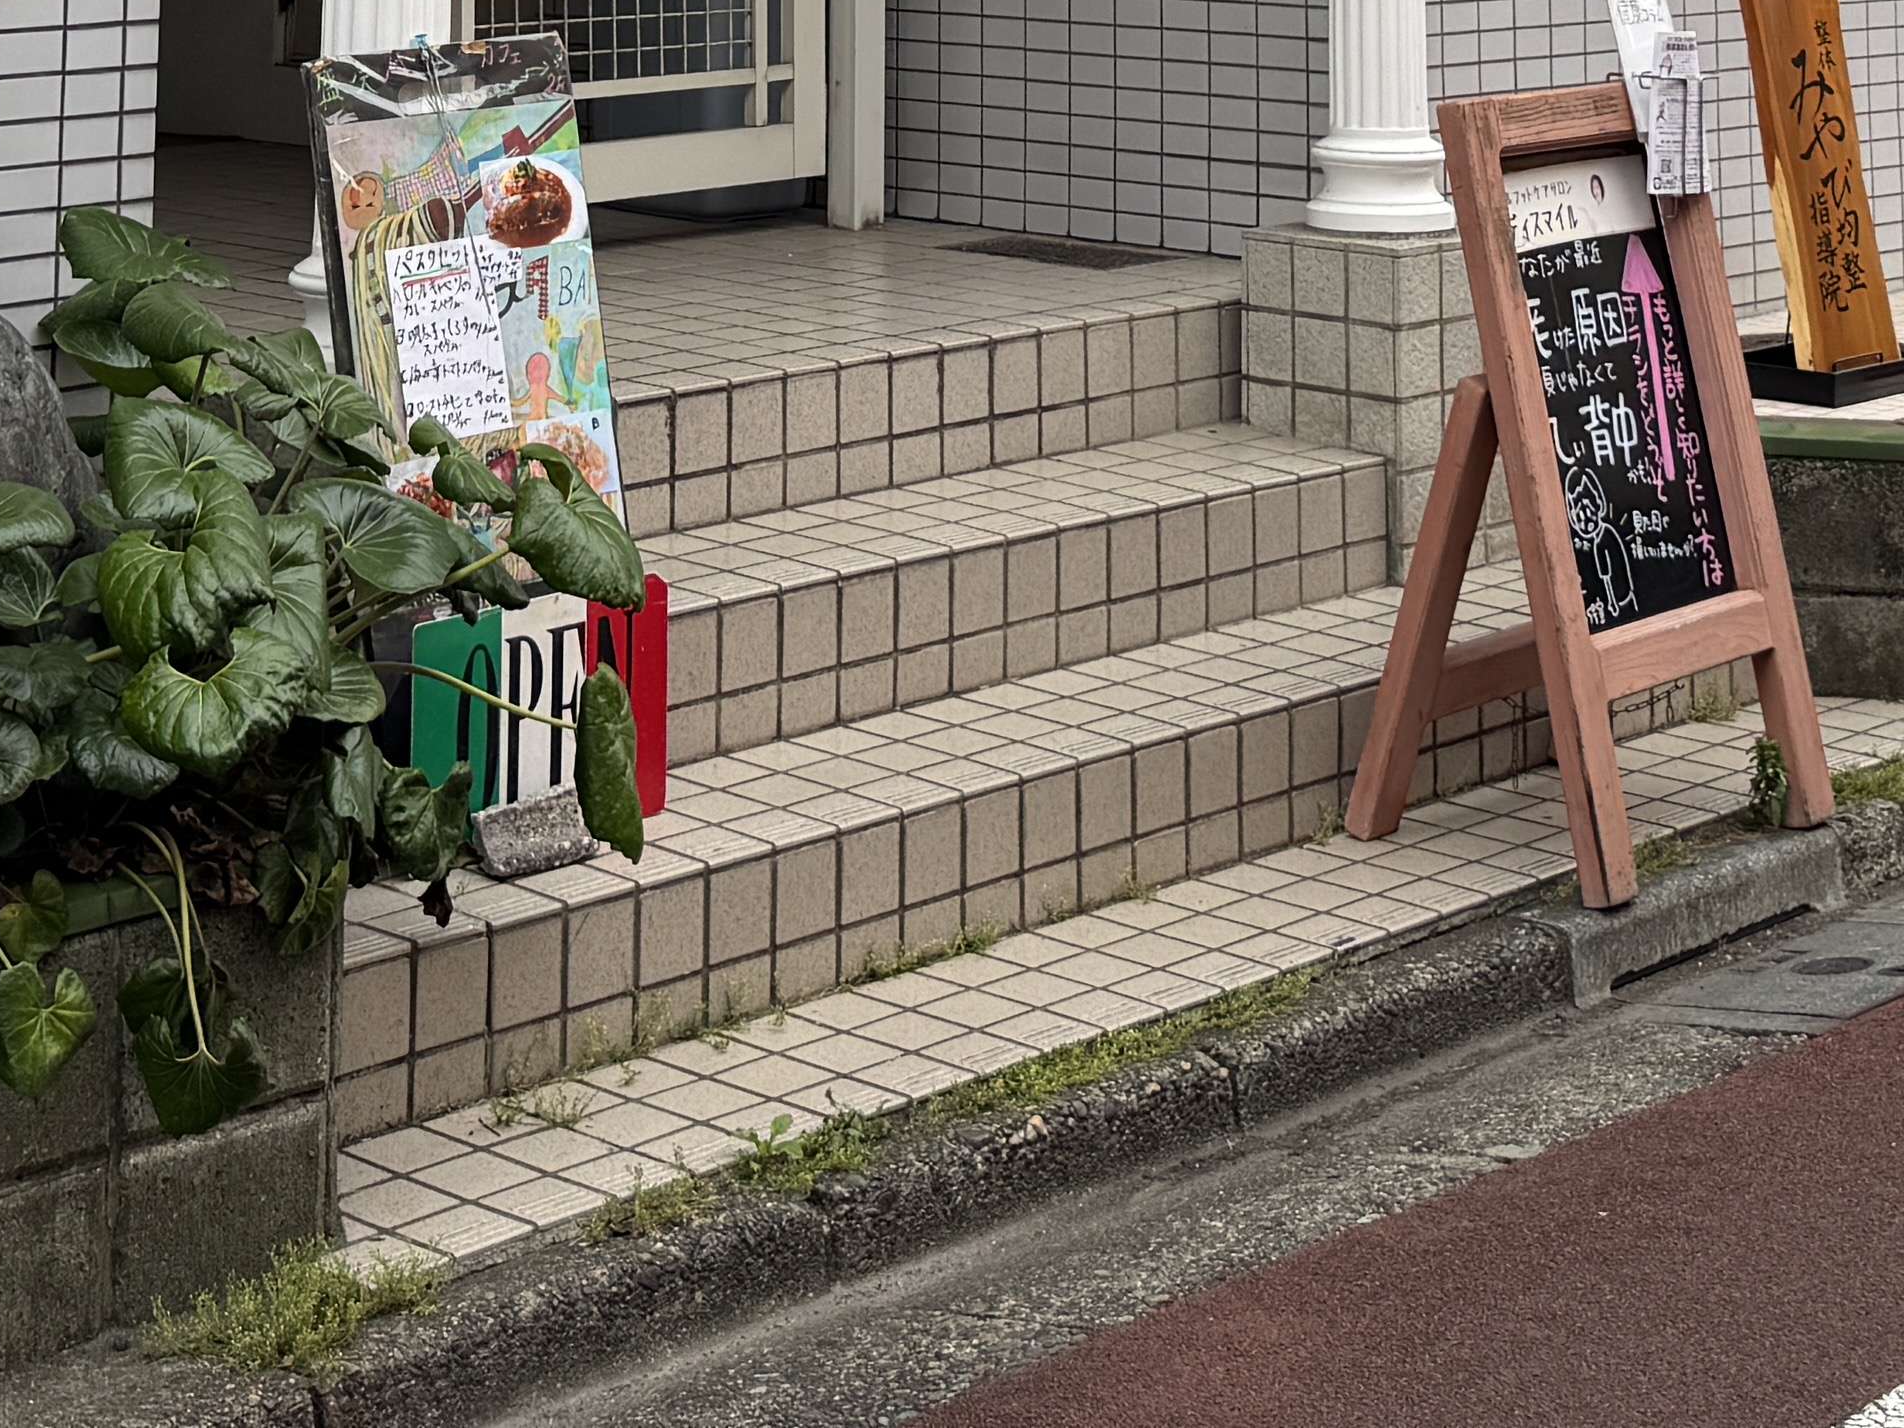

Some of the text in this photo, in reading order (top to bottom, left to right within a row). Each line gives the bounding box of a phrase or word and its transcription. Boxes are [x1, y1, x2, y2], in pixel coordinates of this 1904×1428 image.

[394, 244, 469, 277] パスタセット
[1808, 189, 1849, 314] 指導院
